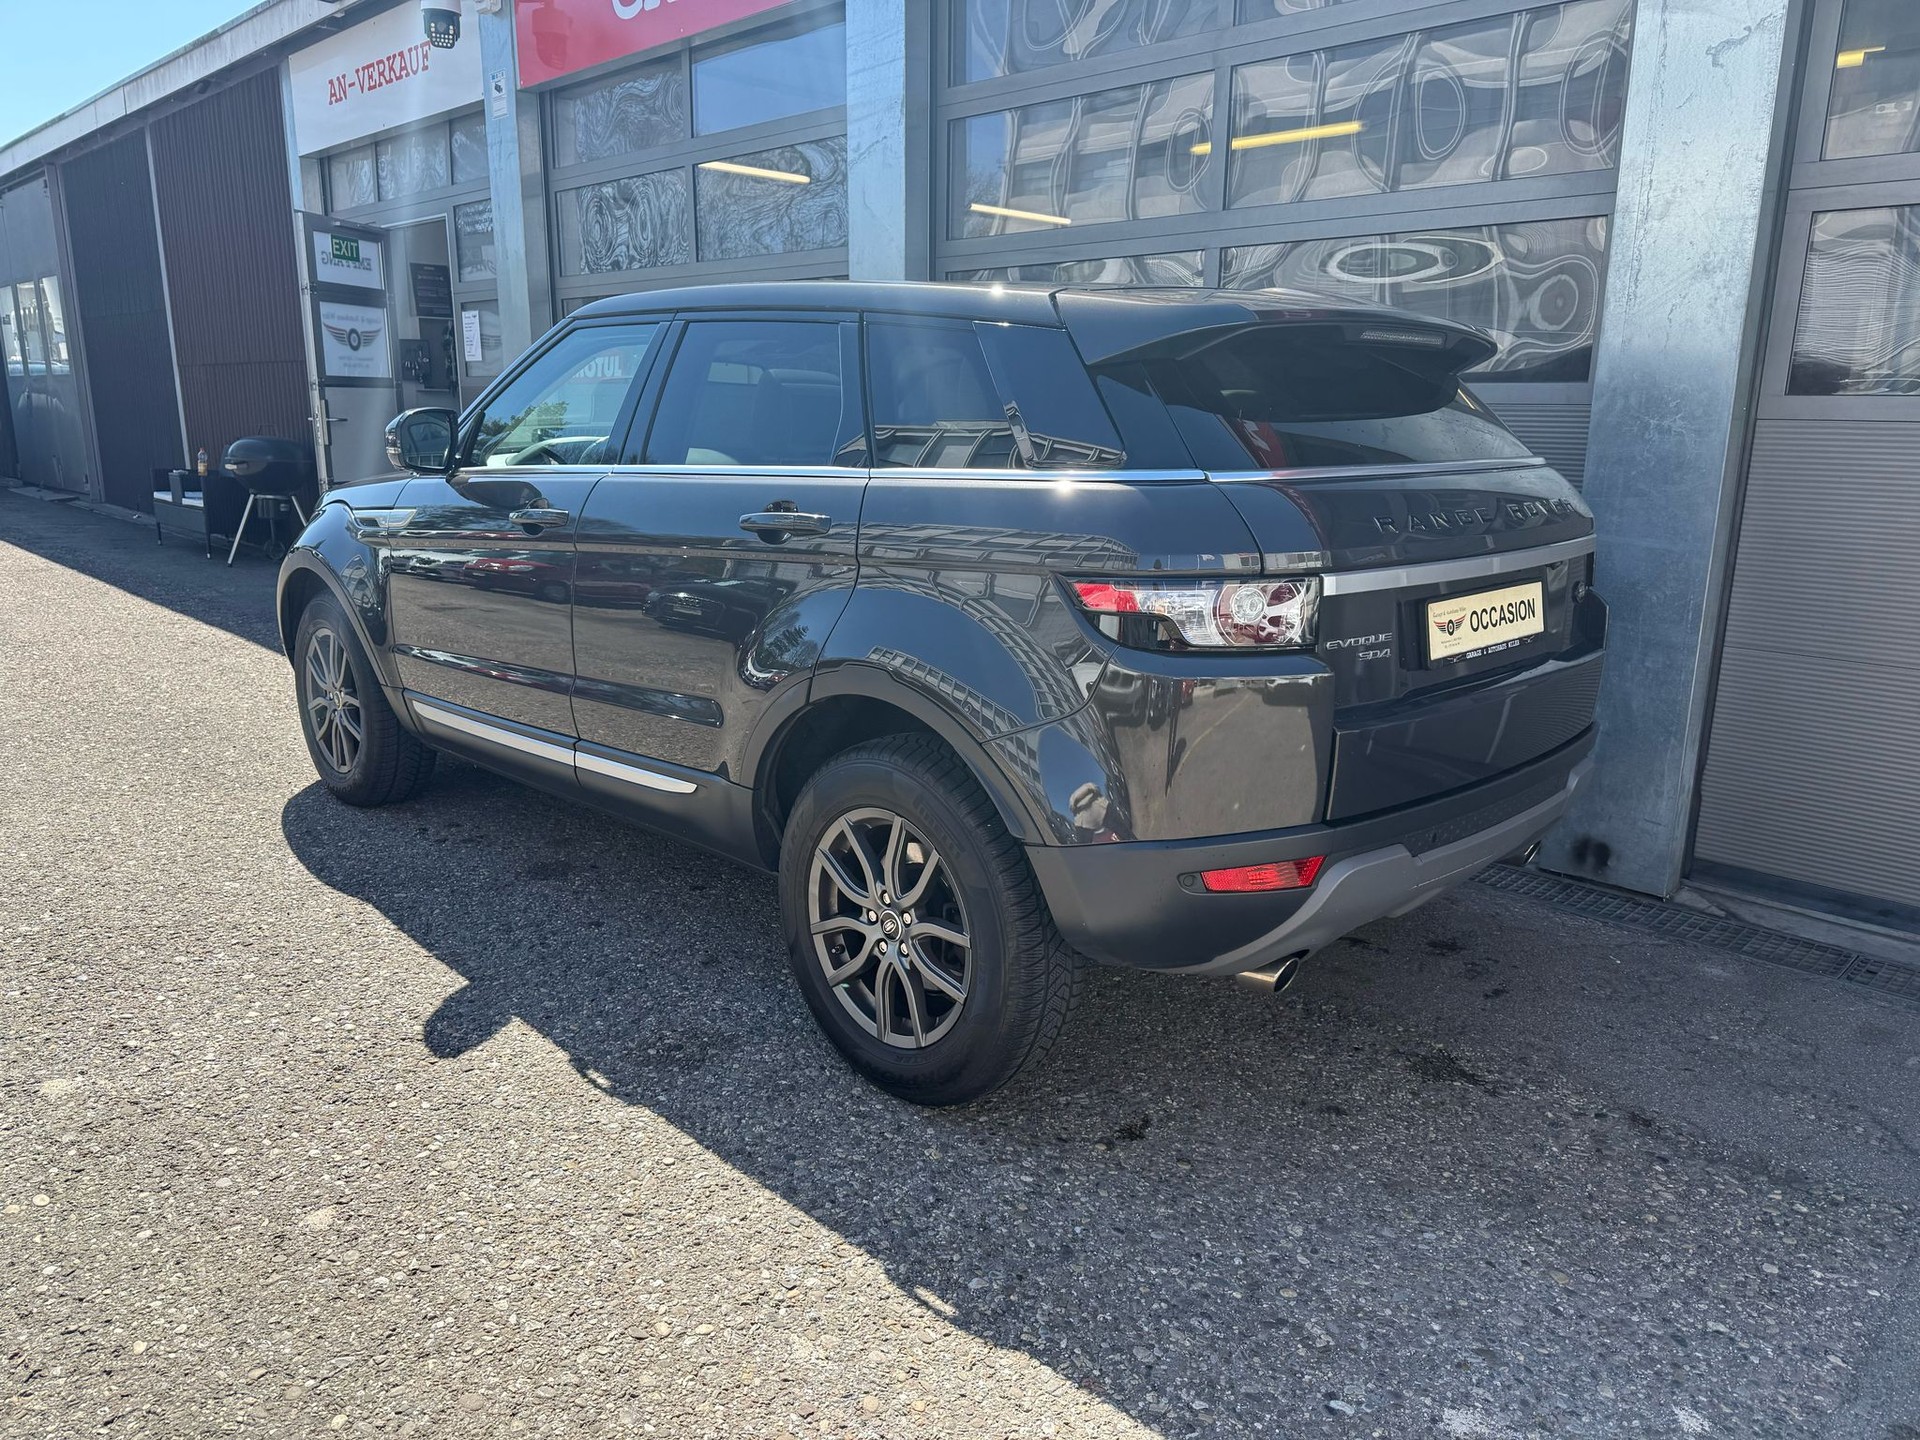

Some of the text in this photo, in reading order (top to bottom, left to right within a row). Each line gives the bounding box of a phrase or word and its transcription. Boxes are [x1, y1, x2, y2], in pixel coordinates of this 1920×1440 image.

[328, 40, 431, 105] AN-VERKAUF
[332, 238, 358, 258] EXIT
[1373, 498, 1575, 534] RANGE ROVER
[1469, 597, 1536, 632] OCCASION
[1326, 632, 1393, 650] EVOQUE
[1358, 648, 1391, 660] SD4
